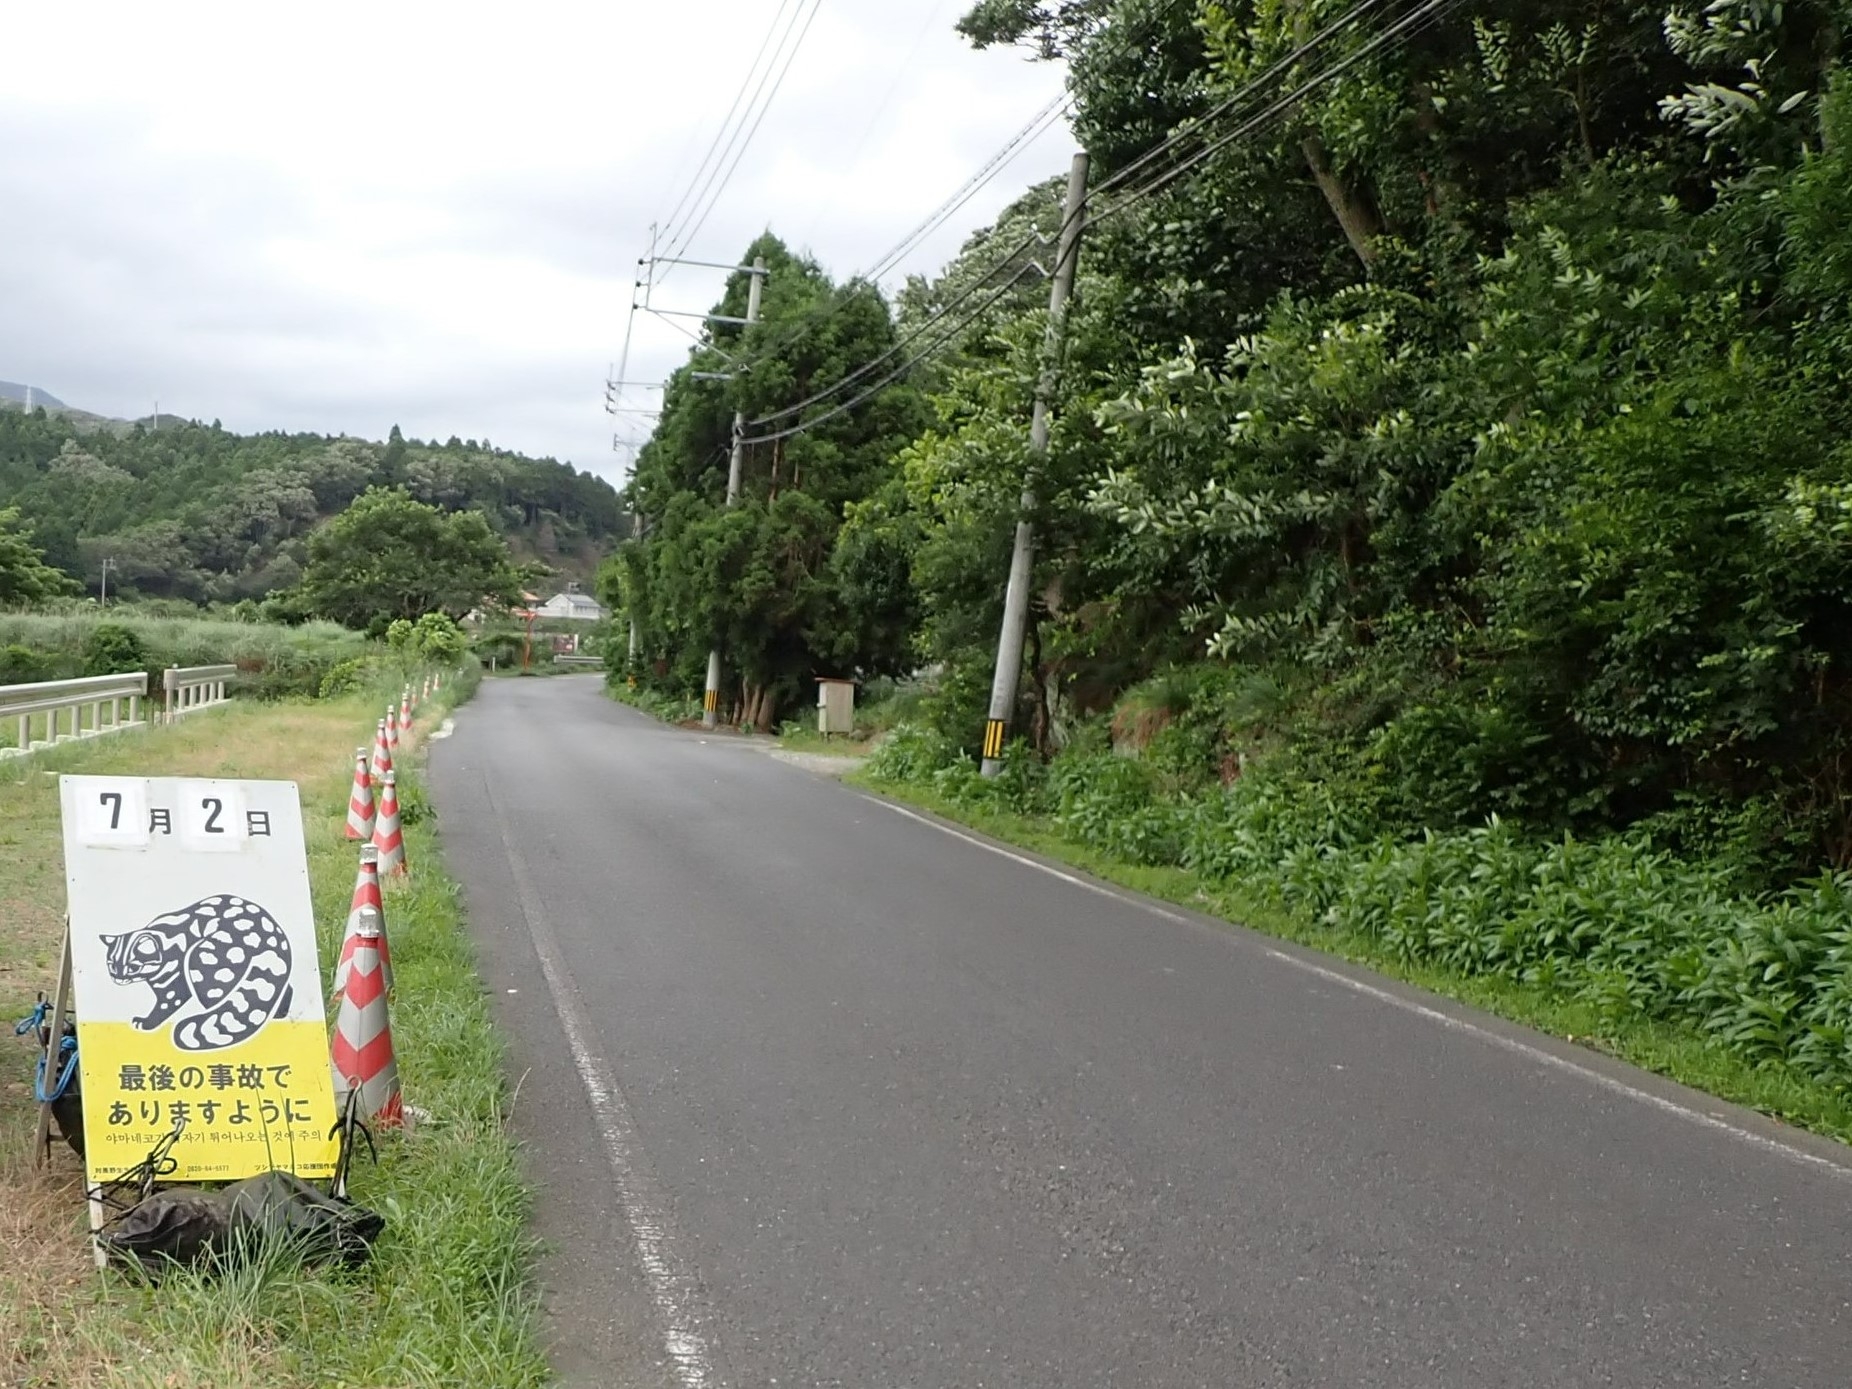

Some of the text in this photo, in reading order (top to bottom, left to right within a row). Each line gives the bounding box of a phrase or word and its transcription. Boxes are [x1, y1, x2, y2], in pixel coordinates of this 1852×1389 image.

[119, 1063, 292, 1091] 最後の事故で
[108, 1099, 312, 1126] ありますように
[298, 1129, 321, 1142] 주의
